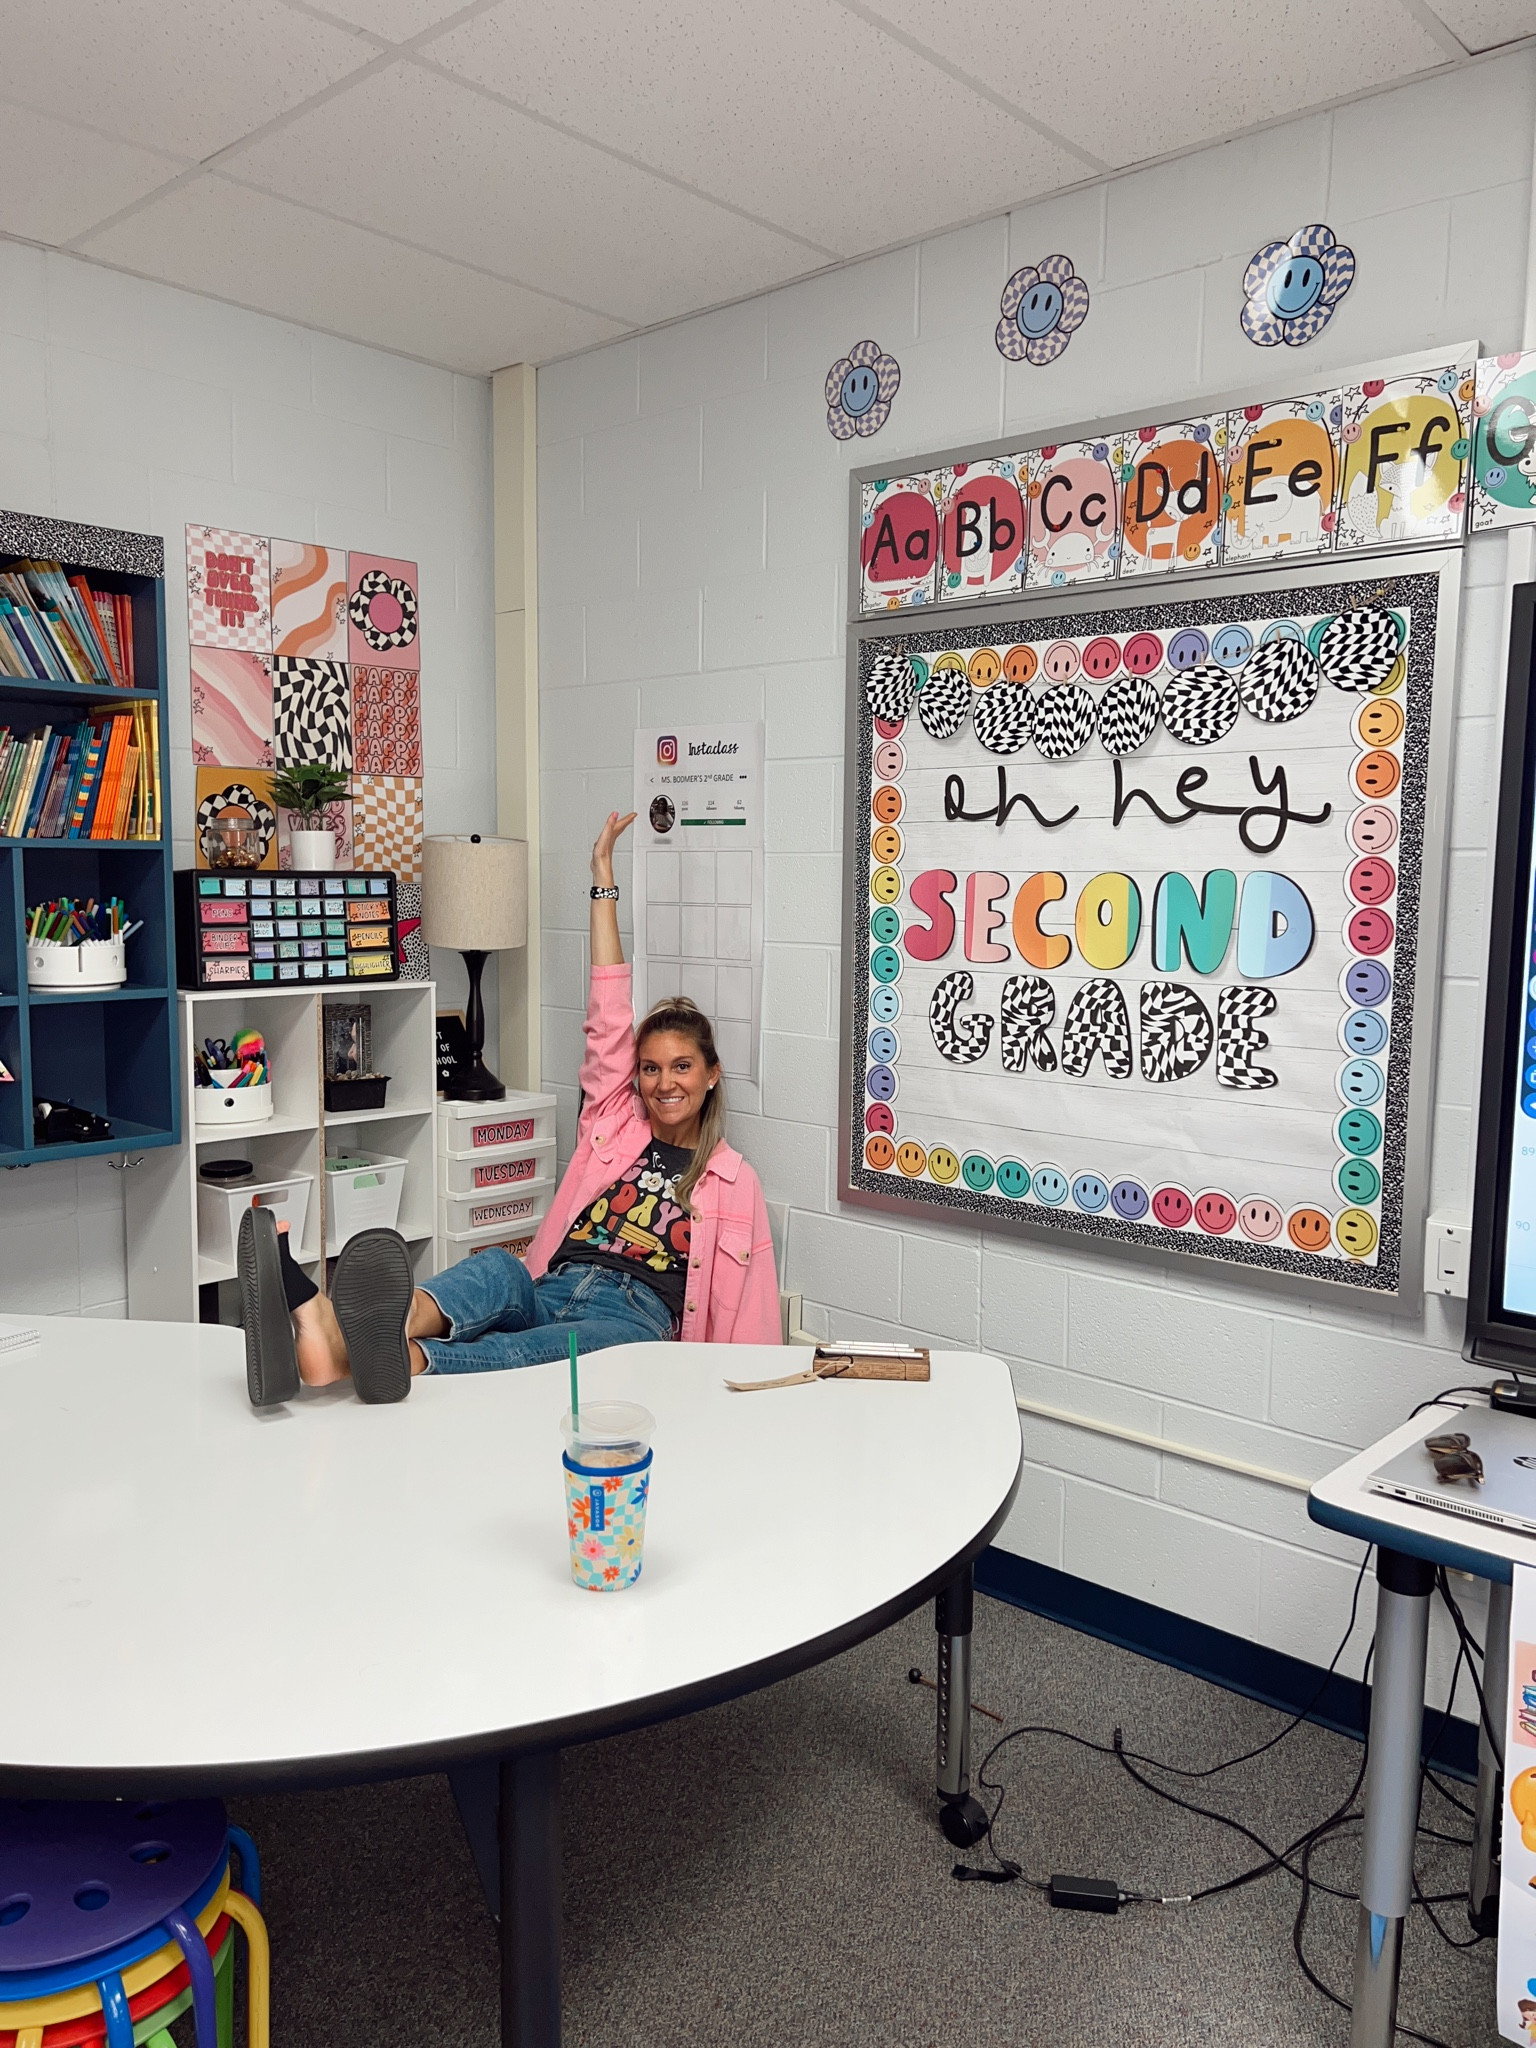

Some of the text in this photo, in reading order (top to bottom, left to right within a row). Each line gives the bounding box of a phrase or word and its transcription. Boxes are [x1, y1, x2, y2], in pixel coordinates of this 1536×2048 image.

[1366, 415, 1451, 494] Ff
[1243, 438, 1323, 506] Ee
[1136, 451, 1209, 523] Dd
[1040, 475, 1106, 533] Cc
[956, 496, 1016, 558] Bb
[1474, 518, 1493, 529] goat
[869, 513, 930, 568] Aa
[1338, 540, 1350, 548] fox
[1225, 552, 1252, 563] elephant
[1122, 567, 1136, 575] deer
[206, 570, 253, 593] OVER
[203, 588, 260, 613] THINK
[688, 740, 739, 756] Instaclass
[713, 773, 734, 783] GRADE
[1111, 754, 1332, 854] hey
[212, 908, 234, 919] PENS
[357, 902, 380, 912] STICKY
[359, 911, 380, 919] NOTES
[903, 868, 1316, 979] SECOND
[211, 933, 239, 943] BINDER
[357, 931, 383, 941] PENCILS
[213, 941, 235, 950] CLIPS
[208, 965, 247, 975] SHARPIES
[928, 970, 1279, 1090] GRADE
[440, 1043, 450, 1053] OF
[477, 1122, 531, 1144] MONDAY
[1521, 1146, 1536, 1157] 89
[478, 1161, 533, 1183] TUESDAY
[474, 1201, 532, 1221] WEDNESDAY
[609, 1183, 684, 1236] DAY
[1515, 1220, 1531, 1232] 90
